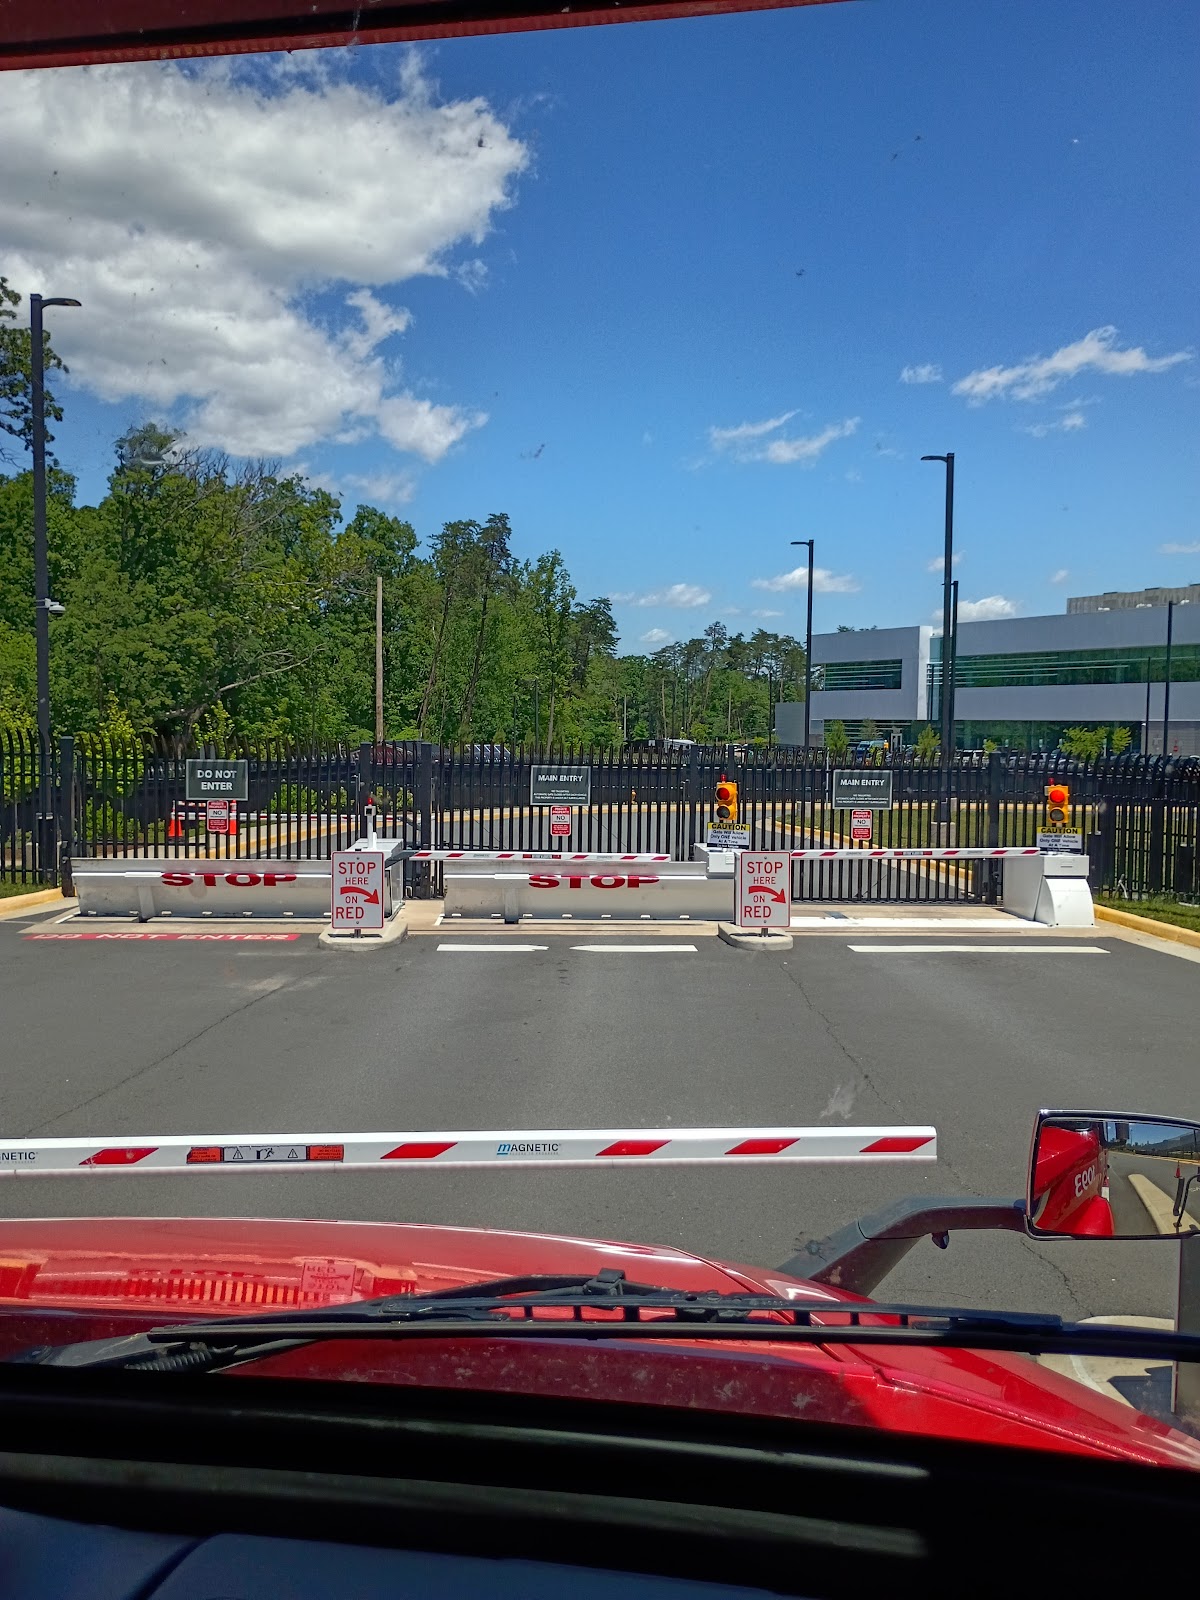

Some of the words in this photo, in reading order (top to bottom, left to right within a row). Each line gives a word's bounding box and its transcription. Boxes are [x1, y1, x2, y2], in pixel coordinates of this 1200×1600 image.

[197, 770, 213, 778] DO
[215, 770, 237, 779] NOT
[201, 782, 233, 790] ENTER
[338, 862, 376, 874] STOP
[747, 862, 783, 874] STOP
[161, 872, 297, 886] STOP
[528, 874, 660, 888] STOP
[336, 907, 364, 919] RED
[744, 906, 771, 918] RED
[0, 1152, 36, 1160] NETIC
